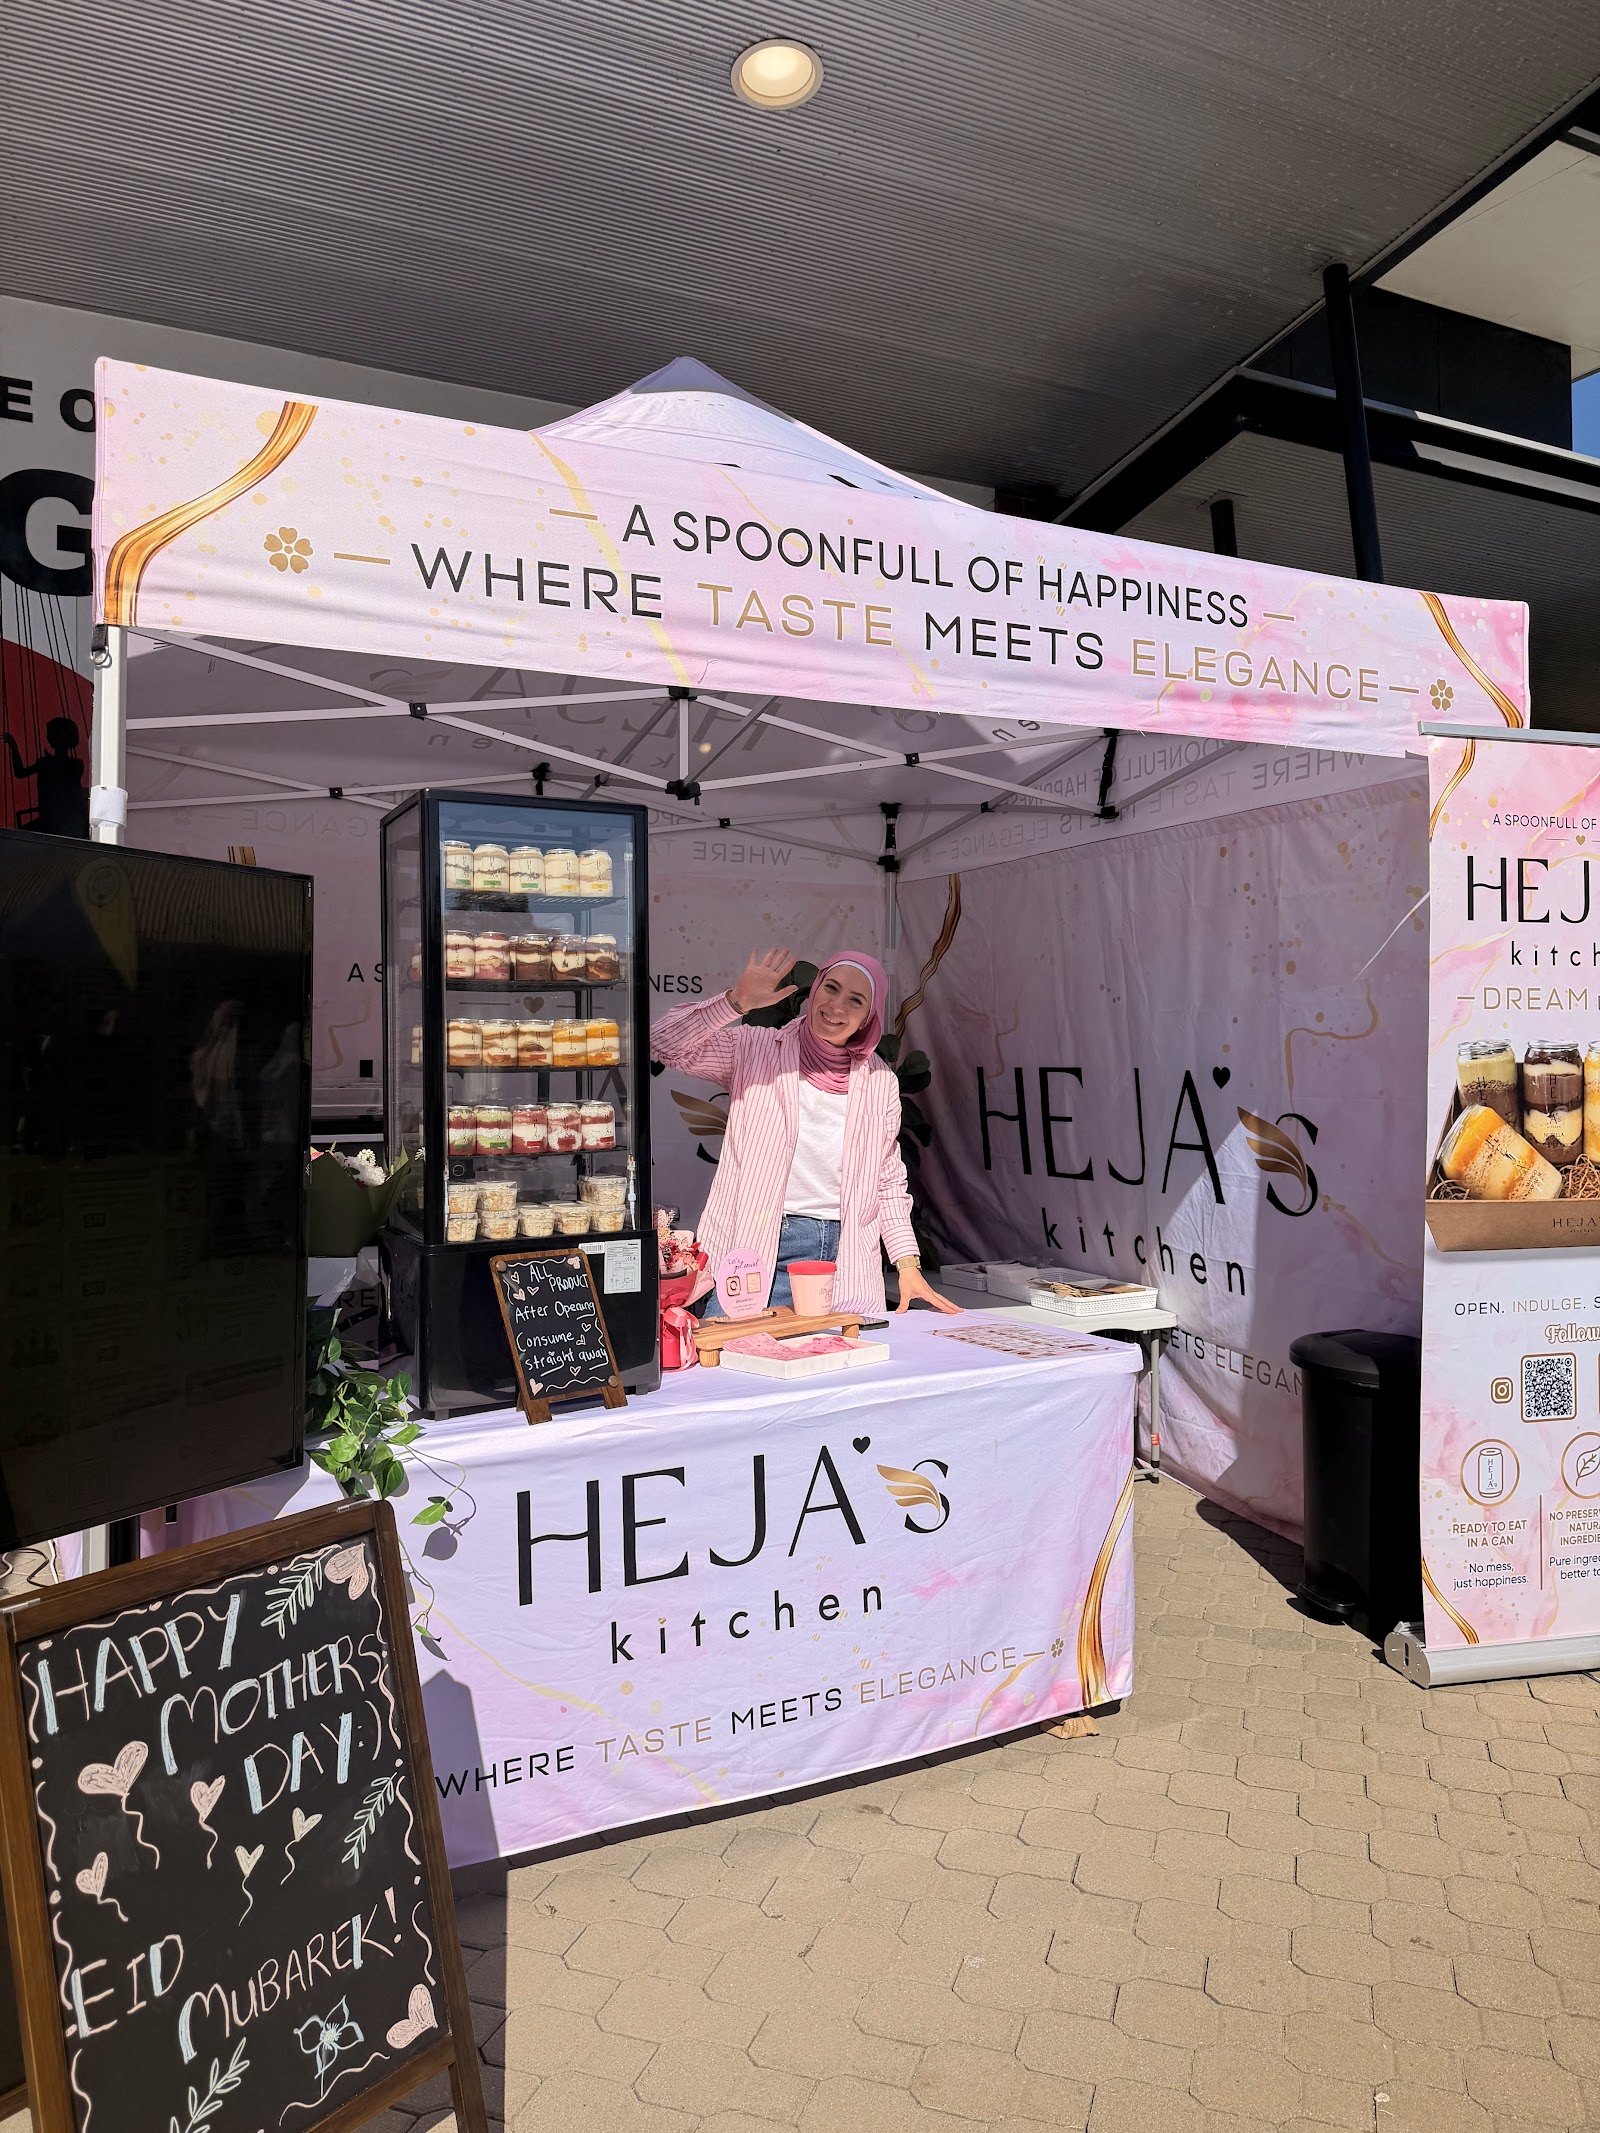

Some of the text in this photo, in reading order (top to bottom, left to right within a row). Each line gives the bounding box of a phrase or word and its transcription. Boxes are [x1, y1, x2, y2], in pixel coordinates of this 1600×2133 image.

[622, 504, 1248, 628] A SPOONFULL OF HAPPINESS
[411, 543, 1379, 703] WHERE TASTE MEETS ELEGANCE
[1492, 813, 1598, 830] A SPOONFULL OF
[1483, 986, 1588, 1010] DREAM
[1041, 1206, 1246, 1296] kitchen
[529, 1265, 552, 1283] ALL
[549, 1273, 590, 1293] PRODUCT
[515, 1300, 596, 1324] After Opening
[1454, 1302, 1505, 1315] OPEN.
[1512, 1297, 1586, 1313] INDULGE.
[516, 1331, 575, 1352] Consume
[525, 1347, 609, 1376] straight away
[1452, 1519, 1528, 1534] READY TO EAT
[1549, 1511, 1564, 1522] NO
[1467, 1535, 1514, 1548] IN A CAN
[1469, 1561, 1514, 1574] No mess,
[1549, 1556, 1571, 1567] Pure
[1453, 1574, 1530, 1591] just happiness.
[1560, 1569, 1590, 1580] better
[611, 1584, 884, 1664] kitchen
[38, 1594, 241, 1735] HAPPY
[435, 1646, 1017, 1800] WHERE TASTE MEETS ELEGANCE
[71, 1934, 184, 2038] EID
